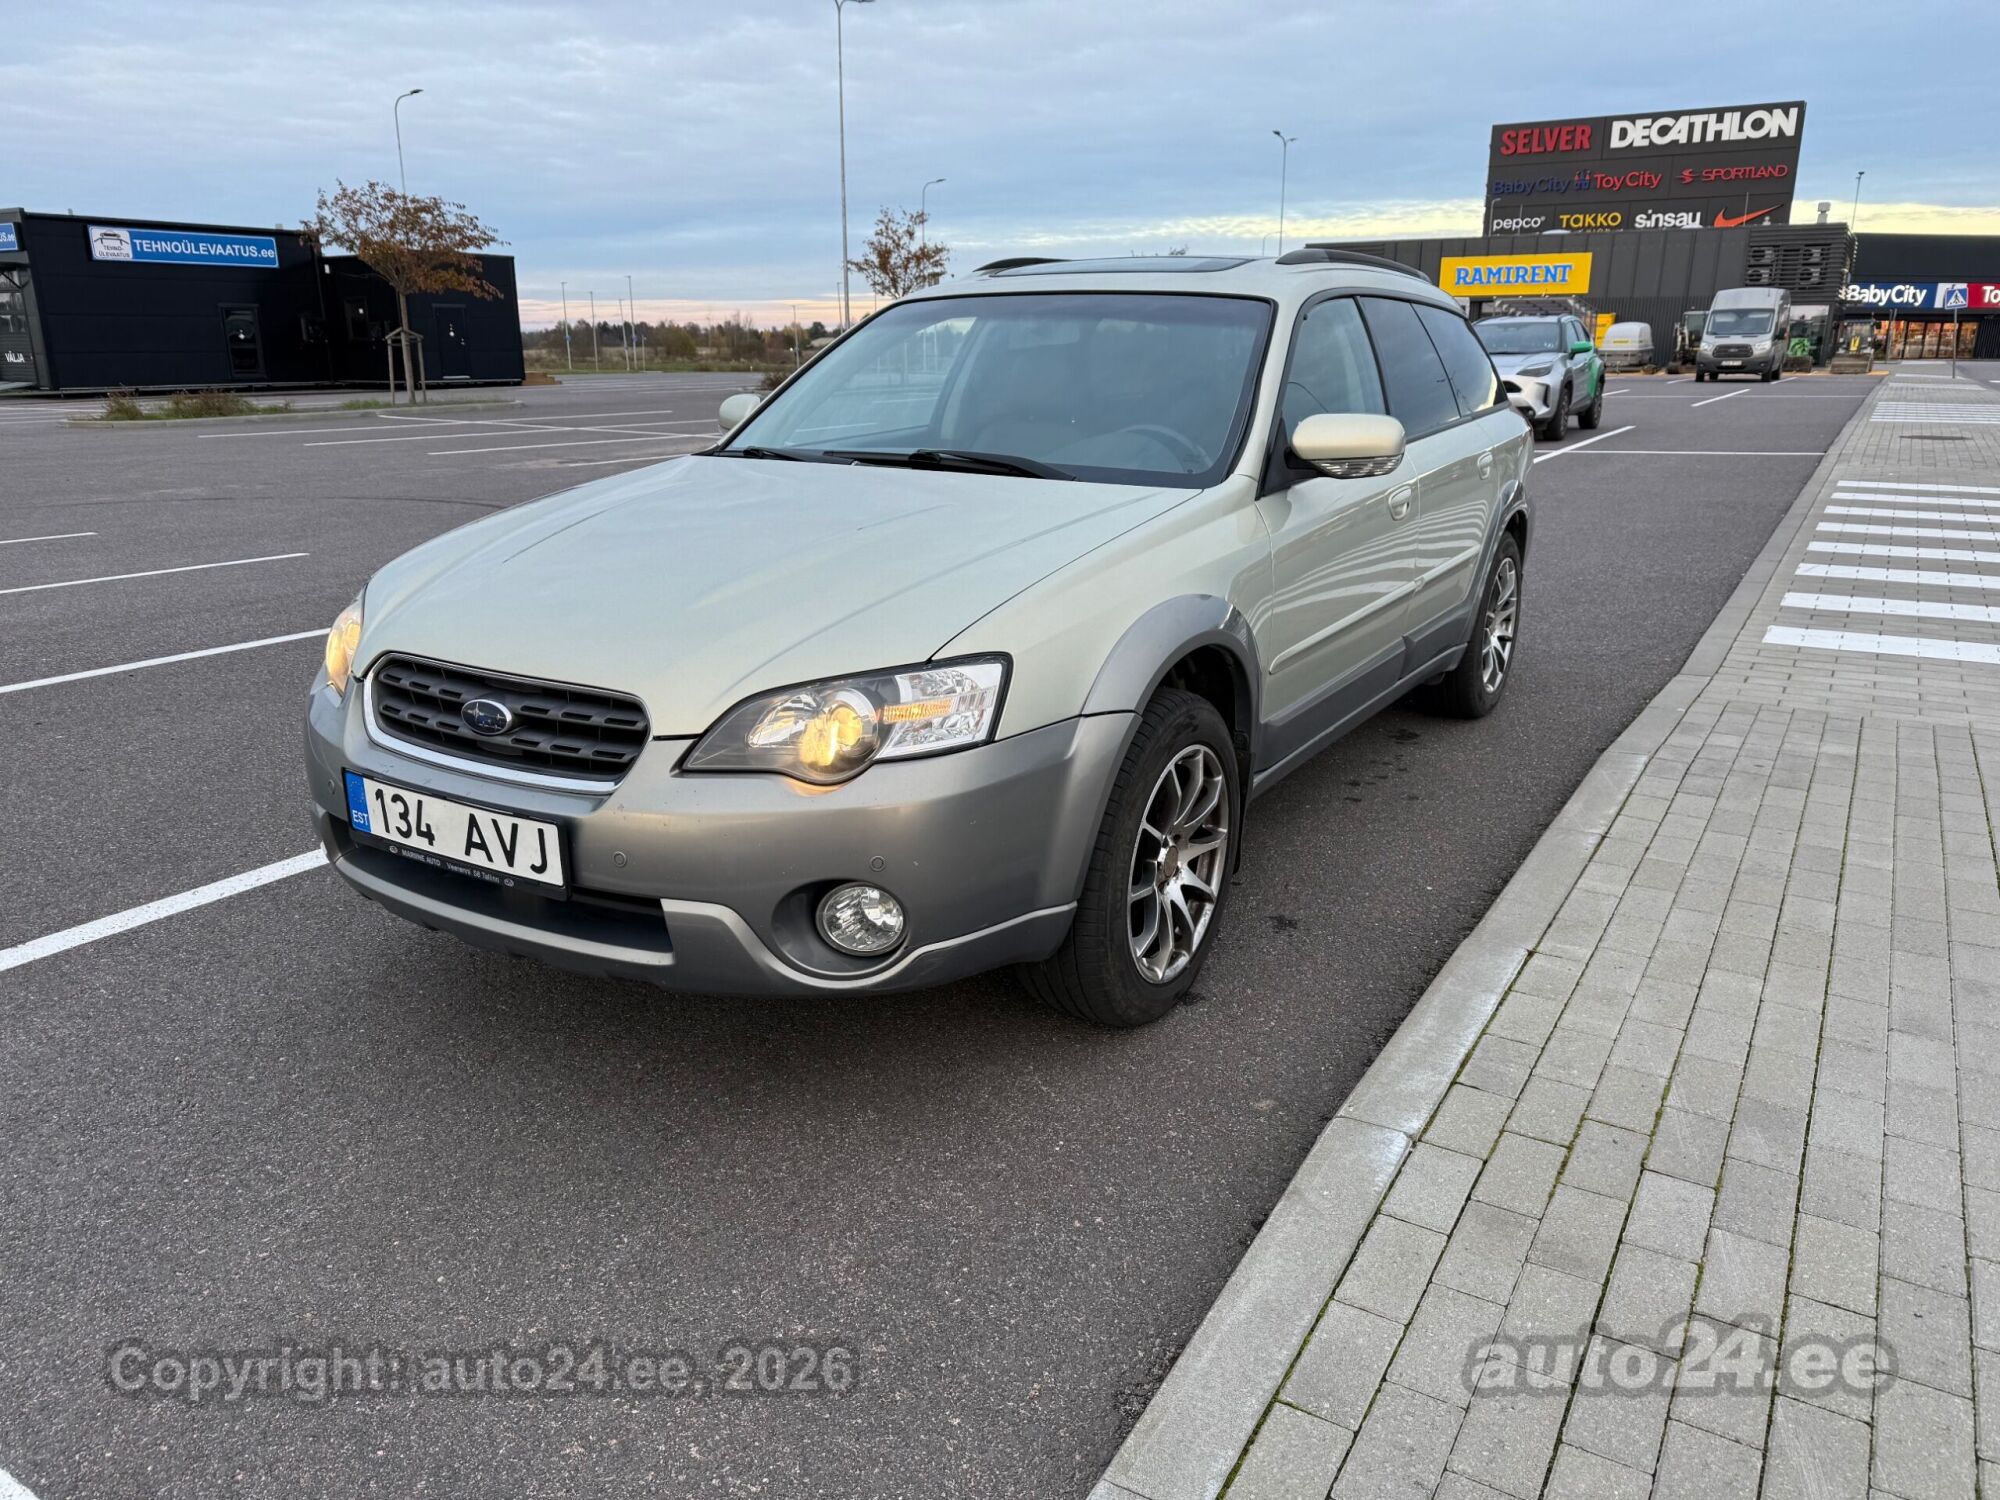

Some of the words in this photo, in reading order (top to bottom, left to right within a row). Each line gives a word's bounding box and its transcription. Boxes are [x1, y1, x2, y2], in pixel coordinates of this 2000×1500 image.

[1610, 107, 1799, 149] DECATHLON
[1500, 125, 1592, 155] SELVER
[1702, 164, 1789, 182] SPORTLAND
[133, 239, 275, 258] TEHNOÜLEVAATUS.ee
[1455, 265, 1573, 286] RAMIRENT
[1847, 284, 1928, 306] BabyCity
[352, 809, 369, 824] EST
[375, 788, 436, 846] 134
[464, 812, 548, 874] AVJ
